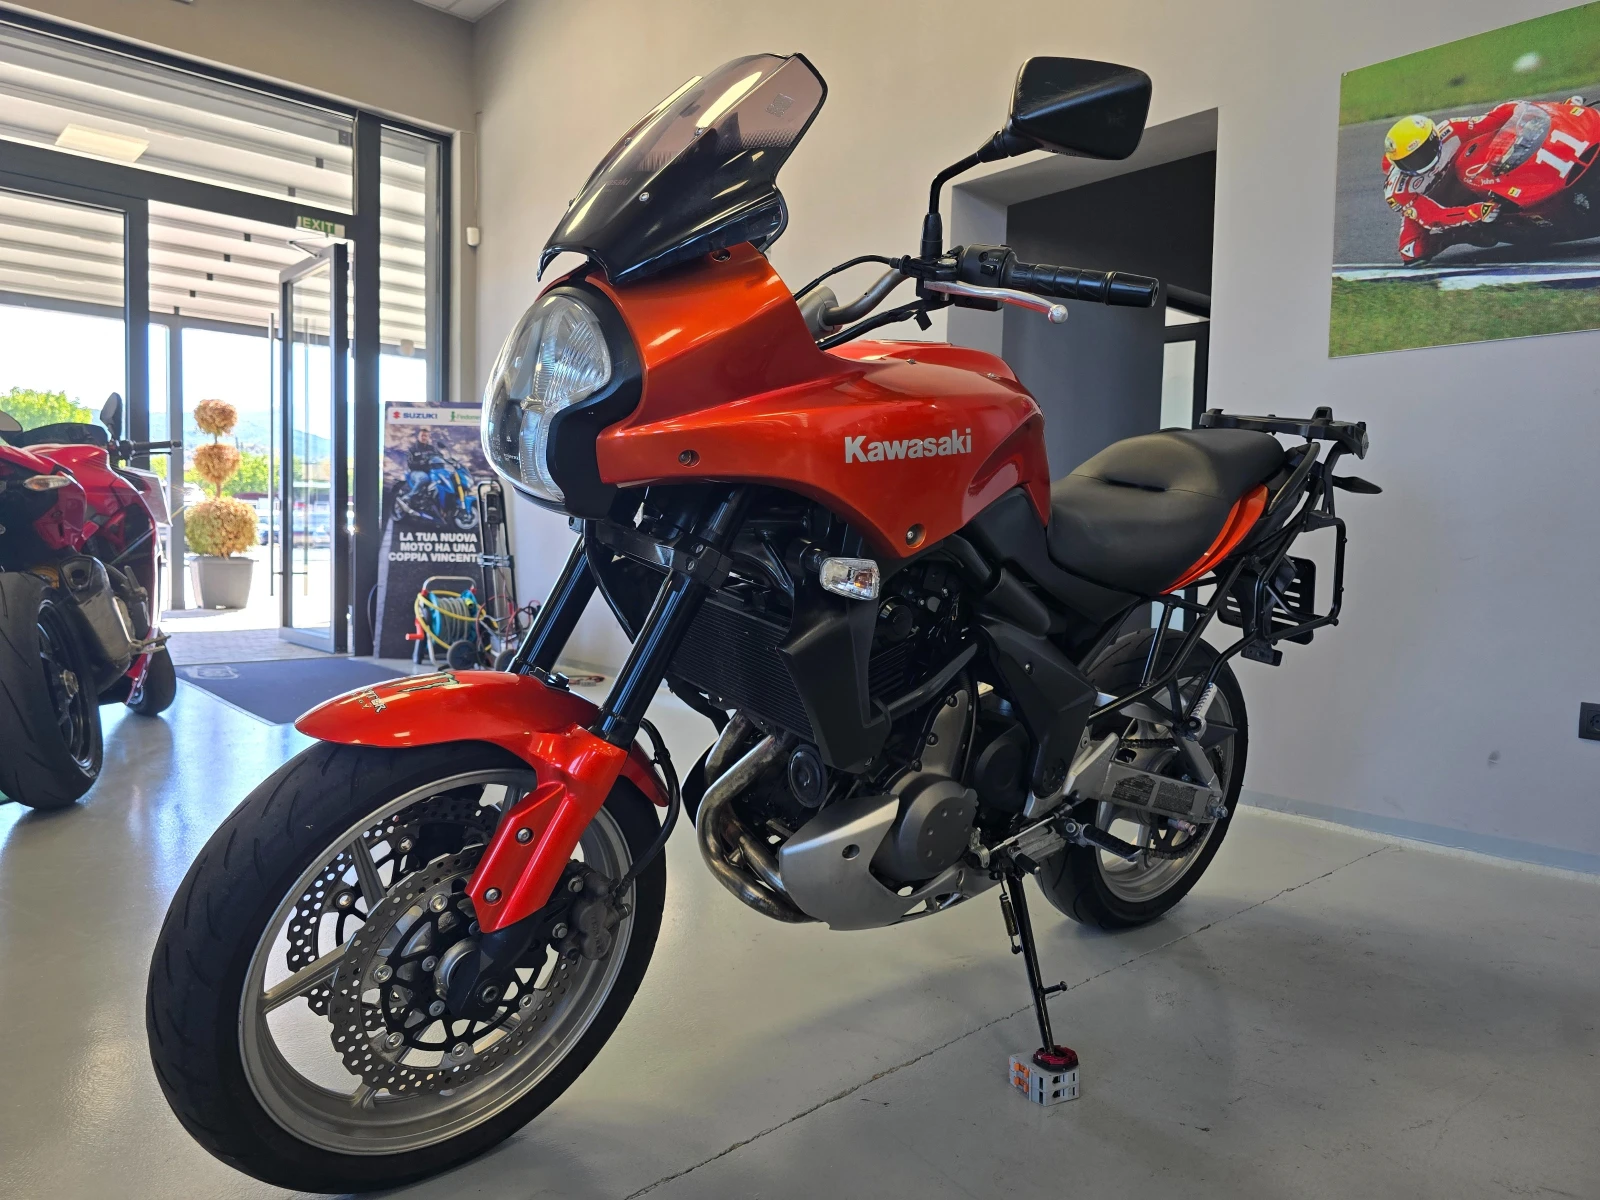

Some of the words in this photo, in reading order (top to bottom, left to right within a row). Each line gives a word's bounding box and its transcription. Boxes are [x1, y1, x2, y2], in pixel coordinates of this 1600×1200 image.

[1535, 129, 1590, 179] 11
[302, 216, 332, 232] EXIT
[844, 428, 972, 464] Kawasaki
[399, 531, 414, 541] LA
[415, 532, 438, 542] TUA
[440, 532, 477, 542] NUOVA
[400, 542, 432, 552] MOTO
[434, 543, 451, 552] HA
[452, 543, 476, 553] UNA
[388, 552, 428, 562] COPPIA
[430, 553, 480, 563] VINCENT
